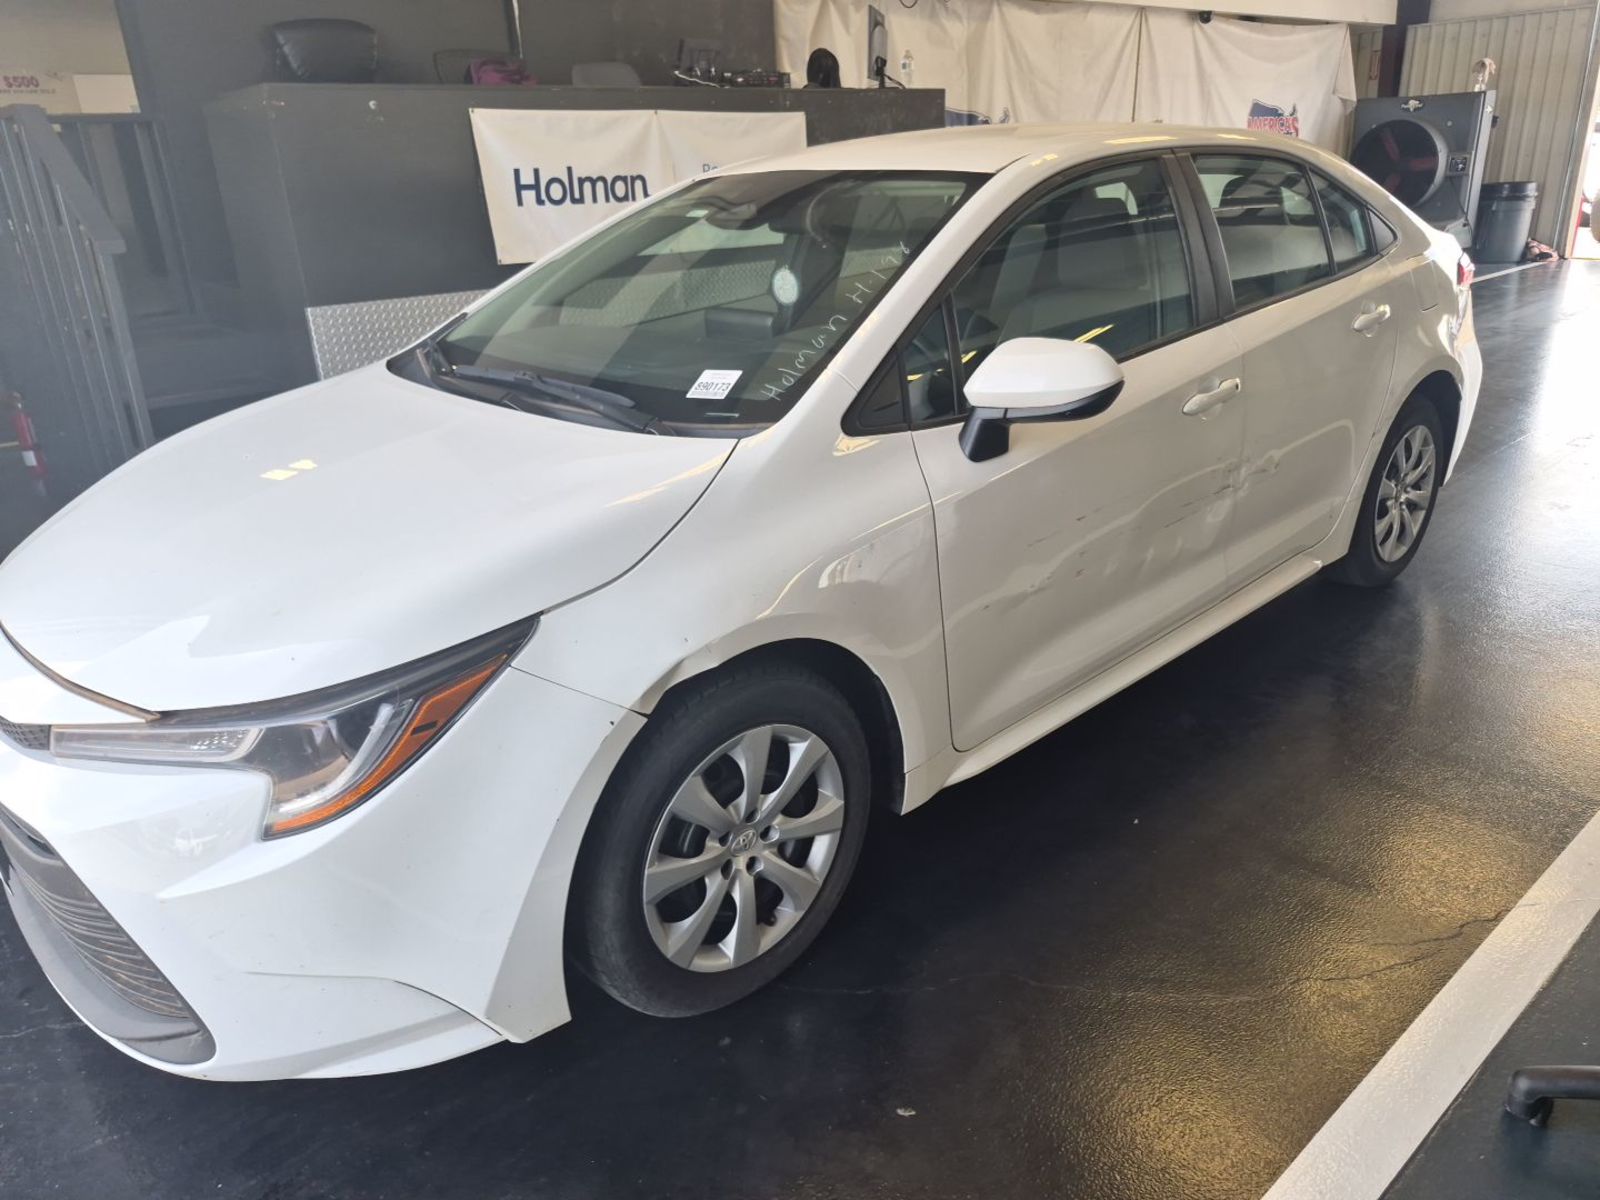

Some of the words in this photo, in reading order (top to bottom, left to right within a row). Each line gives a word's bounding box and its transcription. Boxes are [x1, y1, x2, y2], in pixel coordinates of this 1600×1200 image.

[3, 75, 40, 88] $500
[513, 166, 650, 207] Holman
[760, 314, 849, 400] Holman
